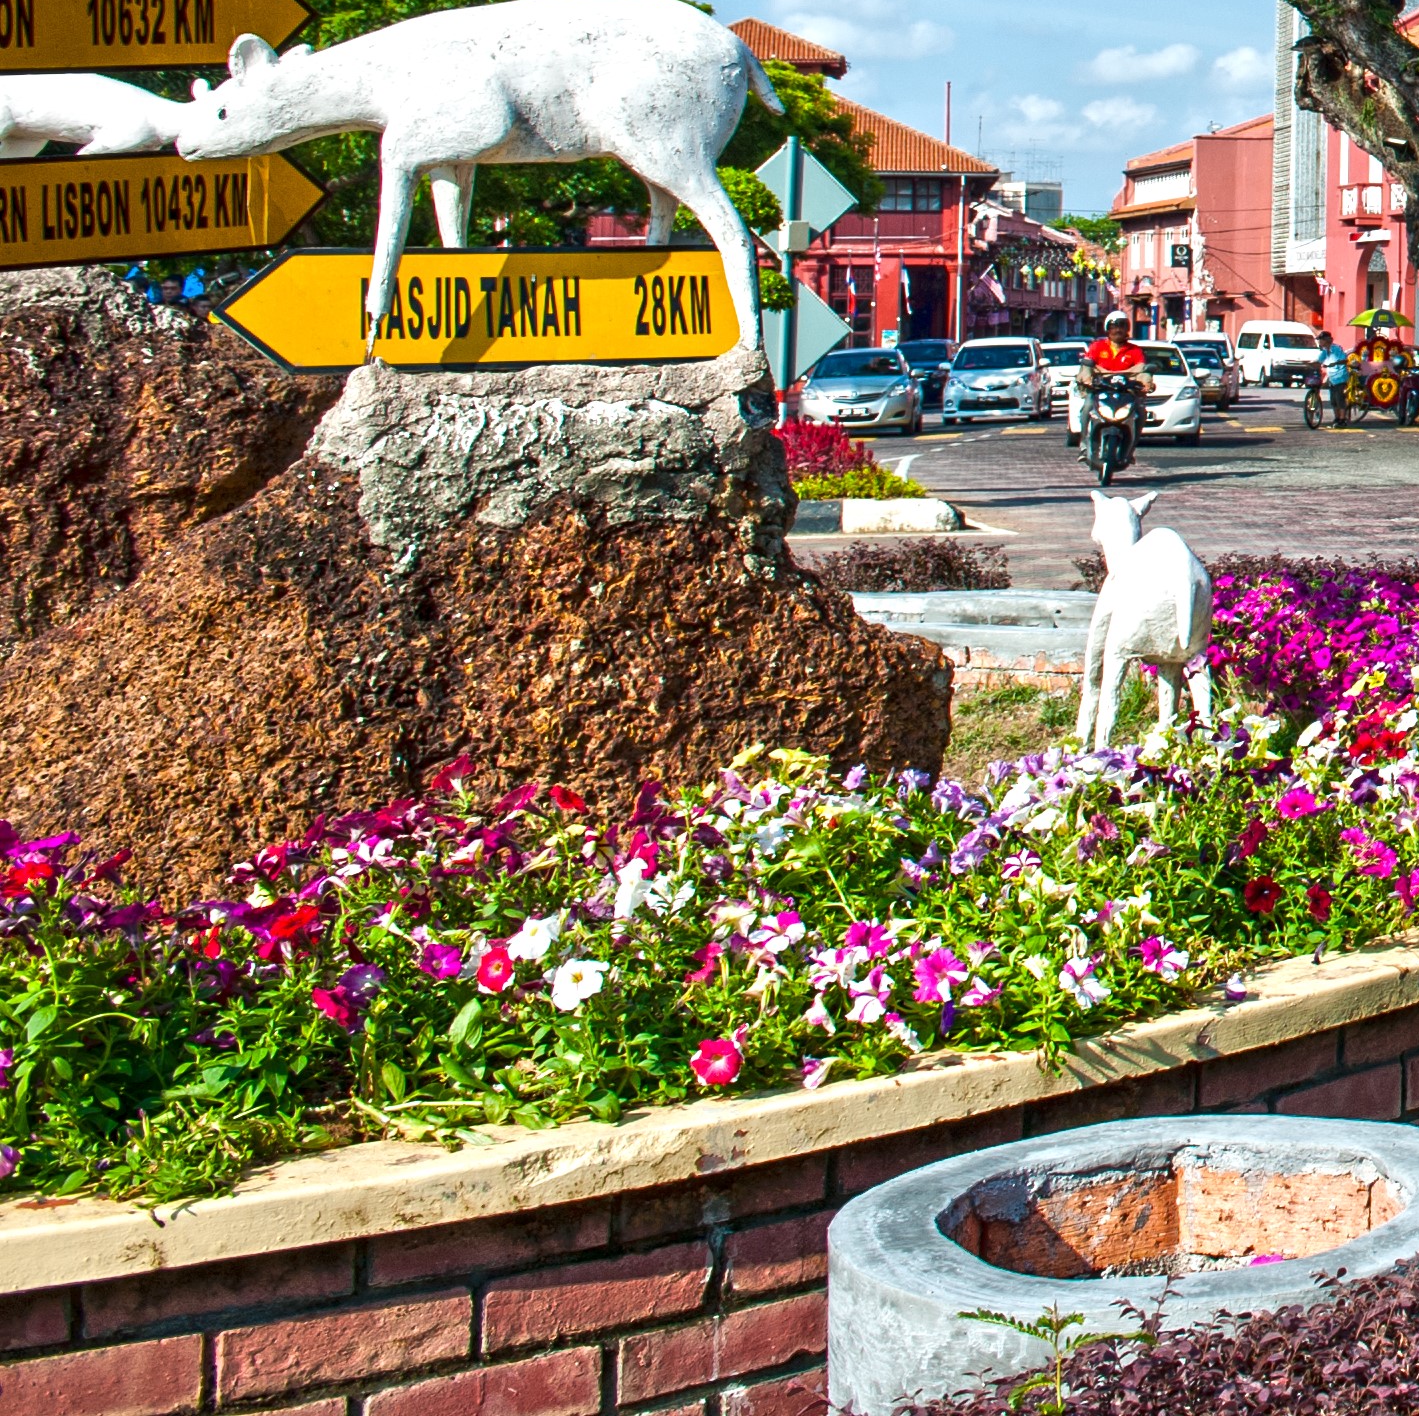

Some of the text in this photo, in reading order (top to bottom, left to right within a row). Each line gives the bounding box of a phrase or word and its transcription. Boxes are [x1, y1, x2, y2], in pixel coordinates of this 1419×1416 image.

[42, 179, 130, 241] LISBON
[140, 174, 208, 234] 10432
[214, 172, 249, 227] KM
[480, 276, 582, 338] TANAH
[634, 275, 712, 336] 28KM
